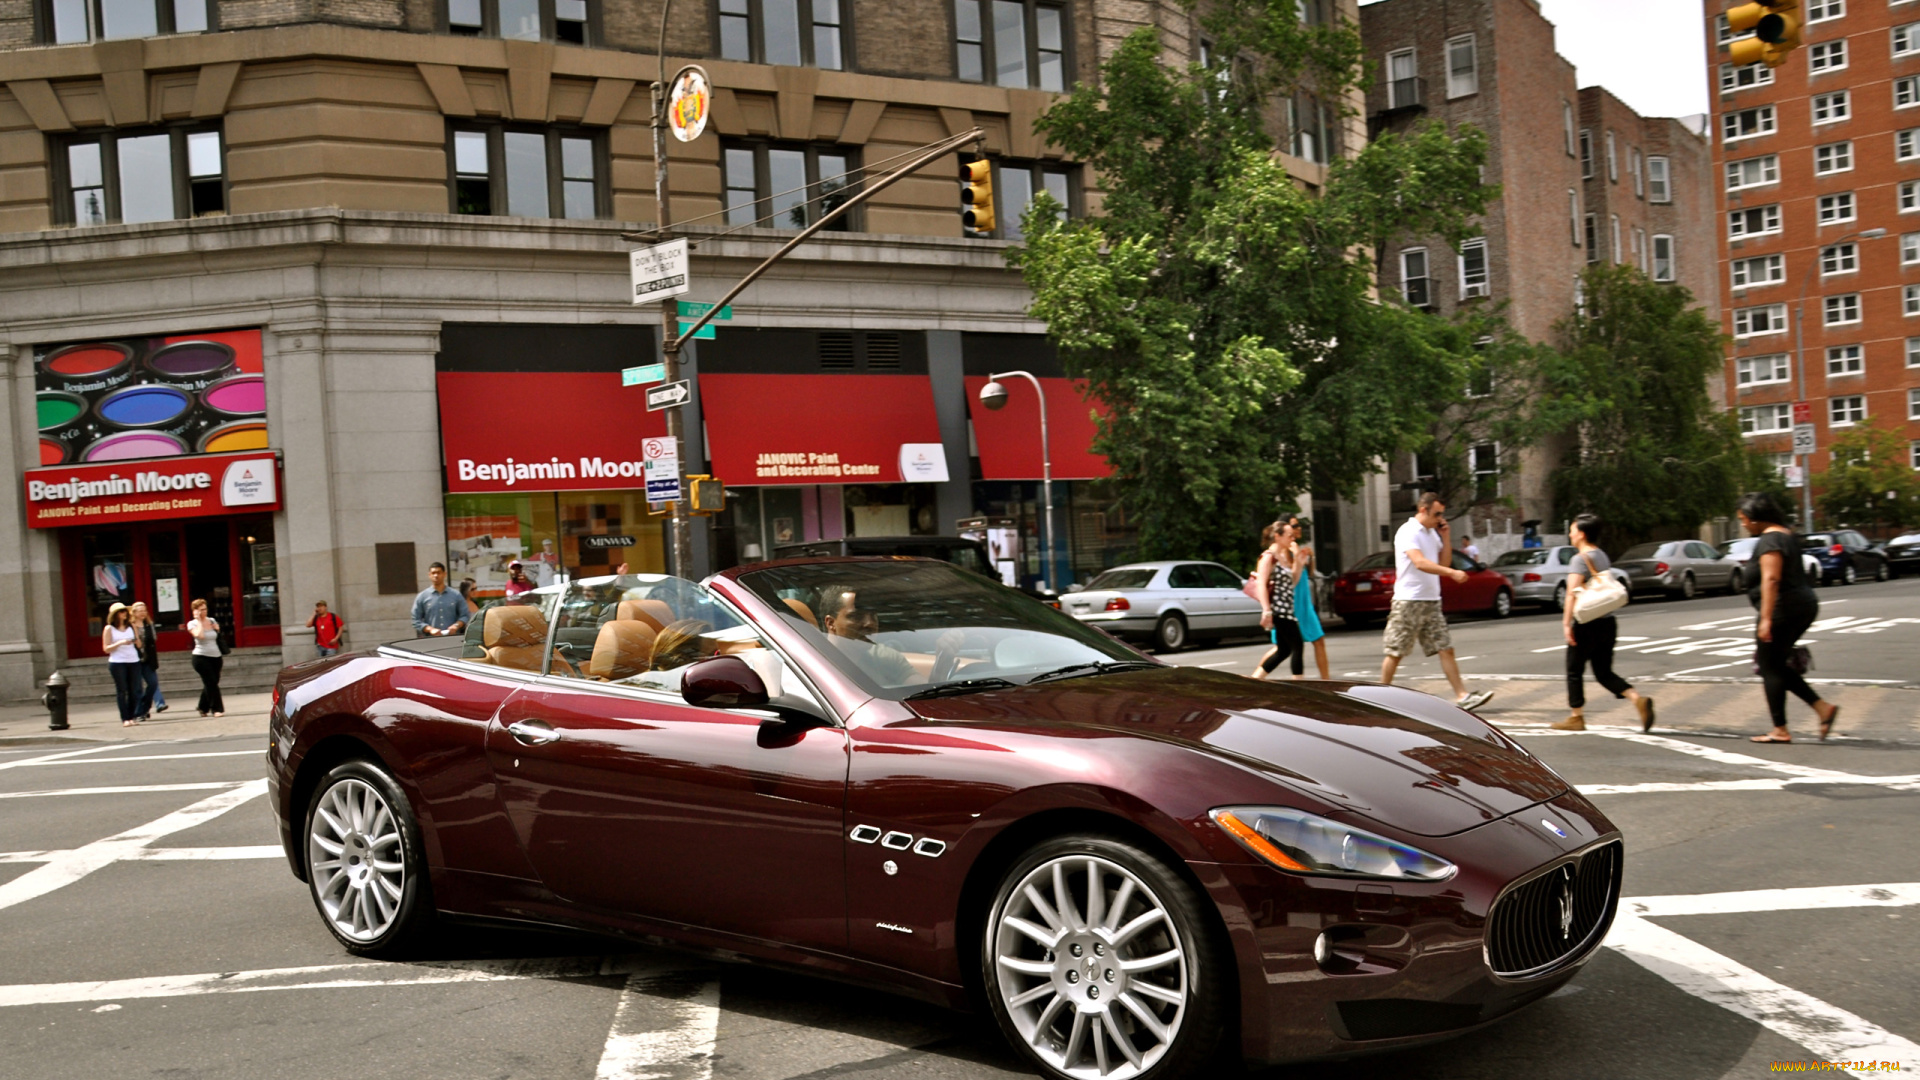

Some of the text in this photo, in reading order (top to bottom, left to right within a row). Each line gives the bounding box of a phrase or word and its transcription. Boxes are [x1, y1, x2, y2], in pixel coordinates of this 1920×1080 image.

[658, 248, 682, 262] BLOCK
[644, 261, 675, 275] THE BOX
[1794, 436, 1813, 446] 30
[756, 452, 839, 465] JANOVIC Paint
[458, 457, 645, 486] Benjamin Moor
[756, 463, 880, 477] and Decorating Center
[28, 471, 212, 504] Benjamin Moore
[37, 498, 202, 519] JANOVIC Paint and Decorating Center
[588, 536, 633, 547] MINWAX
